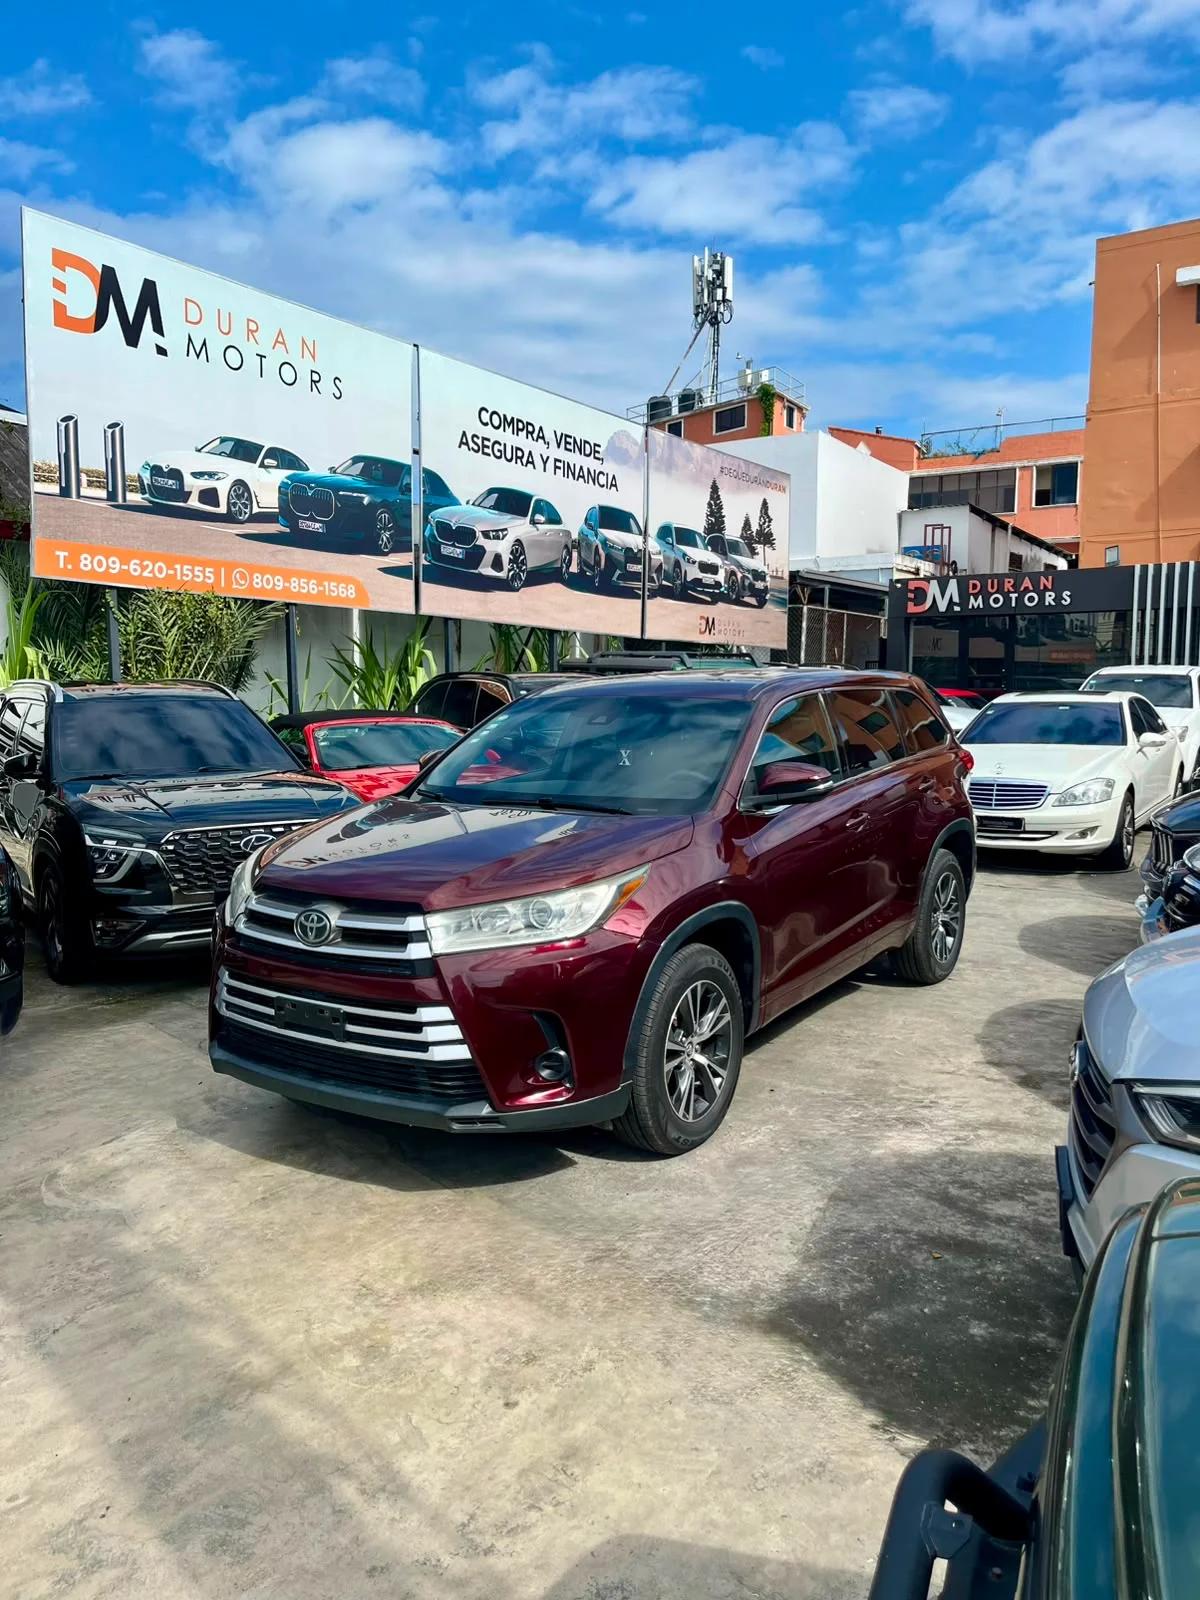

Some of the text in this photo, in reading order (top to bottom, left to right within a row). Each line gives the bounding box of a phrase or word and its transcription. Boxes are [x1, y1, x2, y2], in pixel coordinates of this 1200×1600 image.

[184, 298, 317, 362] DURAN
[186, 333, 343, 400] MOTORS
[458, 430, 619, 492] ASEGURA Y FINANCIA
[478, 406, 604, 465] COMPRA, VENDE,
[55, 550, 356, 600] T. 809-620-1555 809-856-1568
[968, 575, 1054, 594] DURAN
[968, 590, 1072, 610] MOTORS
